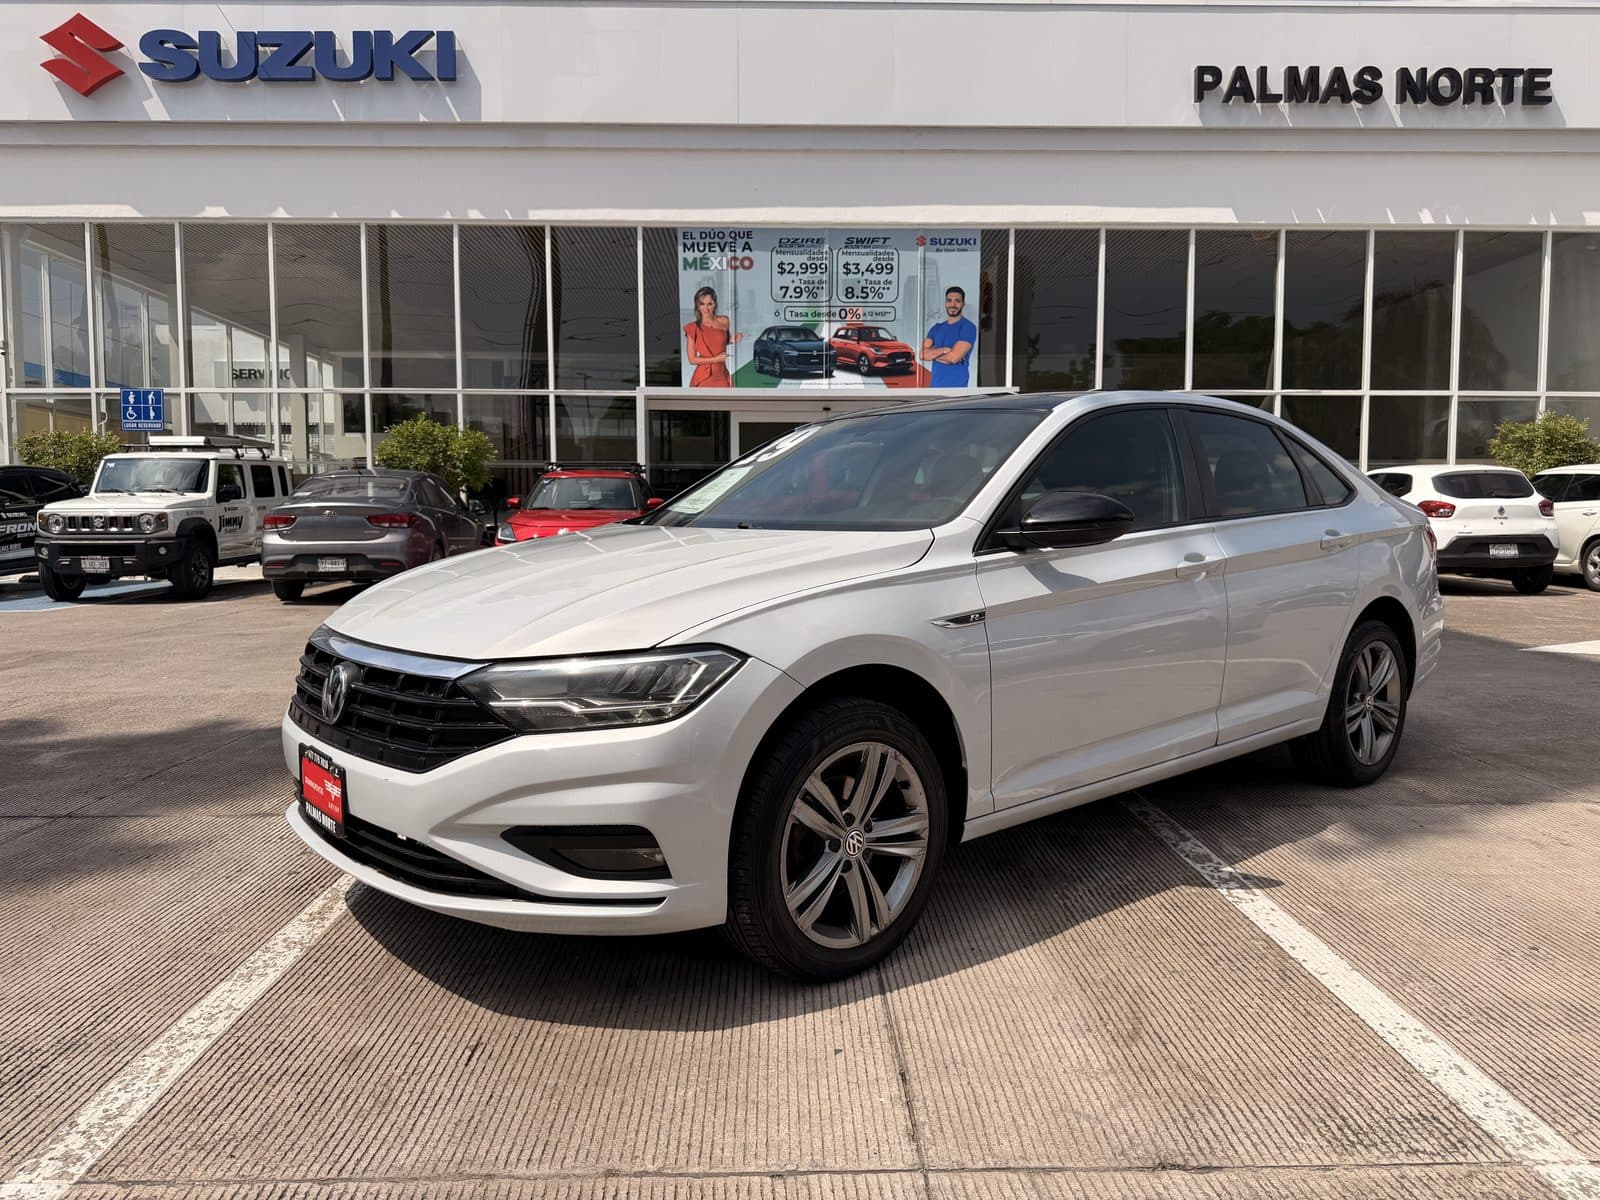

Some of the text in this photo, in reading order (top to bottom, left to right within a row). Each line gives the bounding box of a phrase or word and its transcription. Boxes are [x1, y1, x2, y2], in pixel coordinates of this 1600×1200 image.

[138, 29, 457, 83] SUZUKI
[1193, 65, 1553, 106] PALMAS NORTE
[682, 229, 754, 241] EL DÚO QUE
[929, 237, 977, 246] SUZUKI
[682, 241, 753, 253] MUEVE A
[682, 252, 754, 271] MÉXICO
[777, 261, 828, 276] $2,999
[842, 261, 894, 277] $3,499
[789, 310, 810, 318] Tasa
[810, 310, 837, 318] desde
[838, 308, 861, 320] 0%
